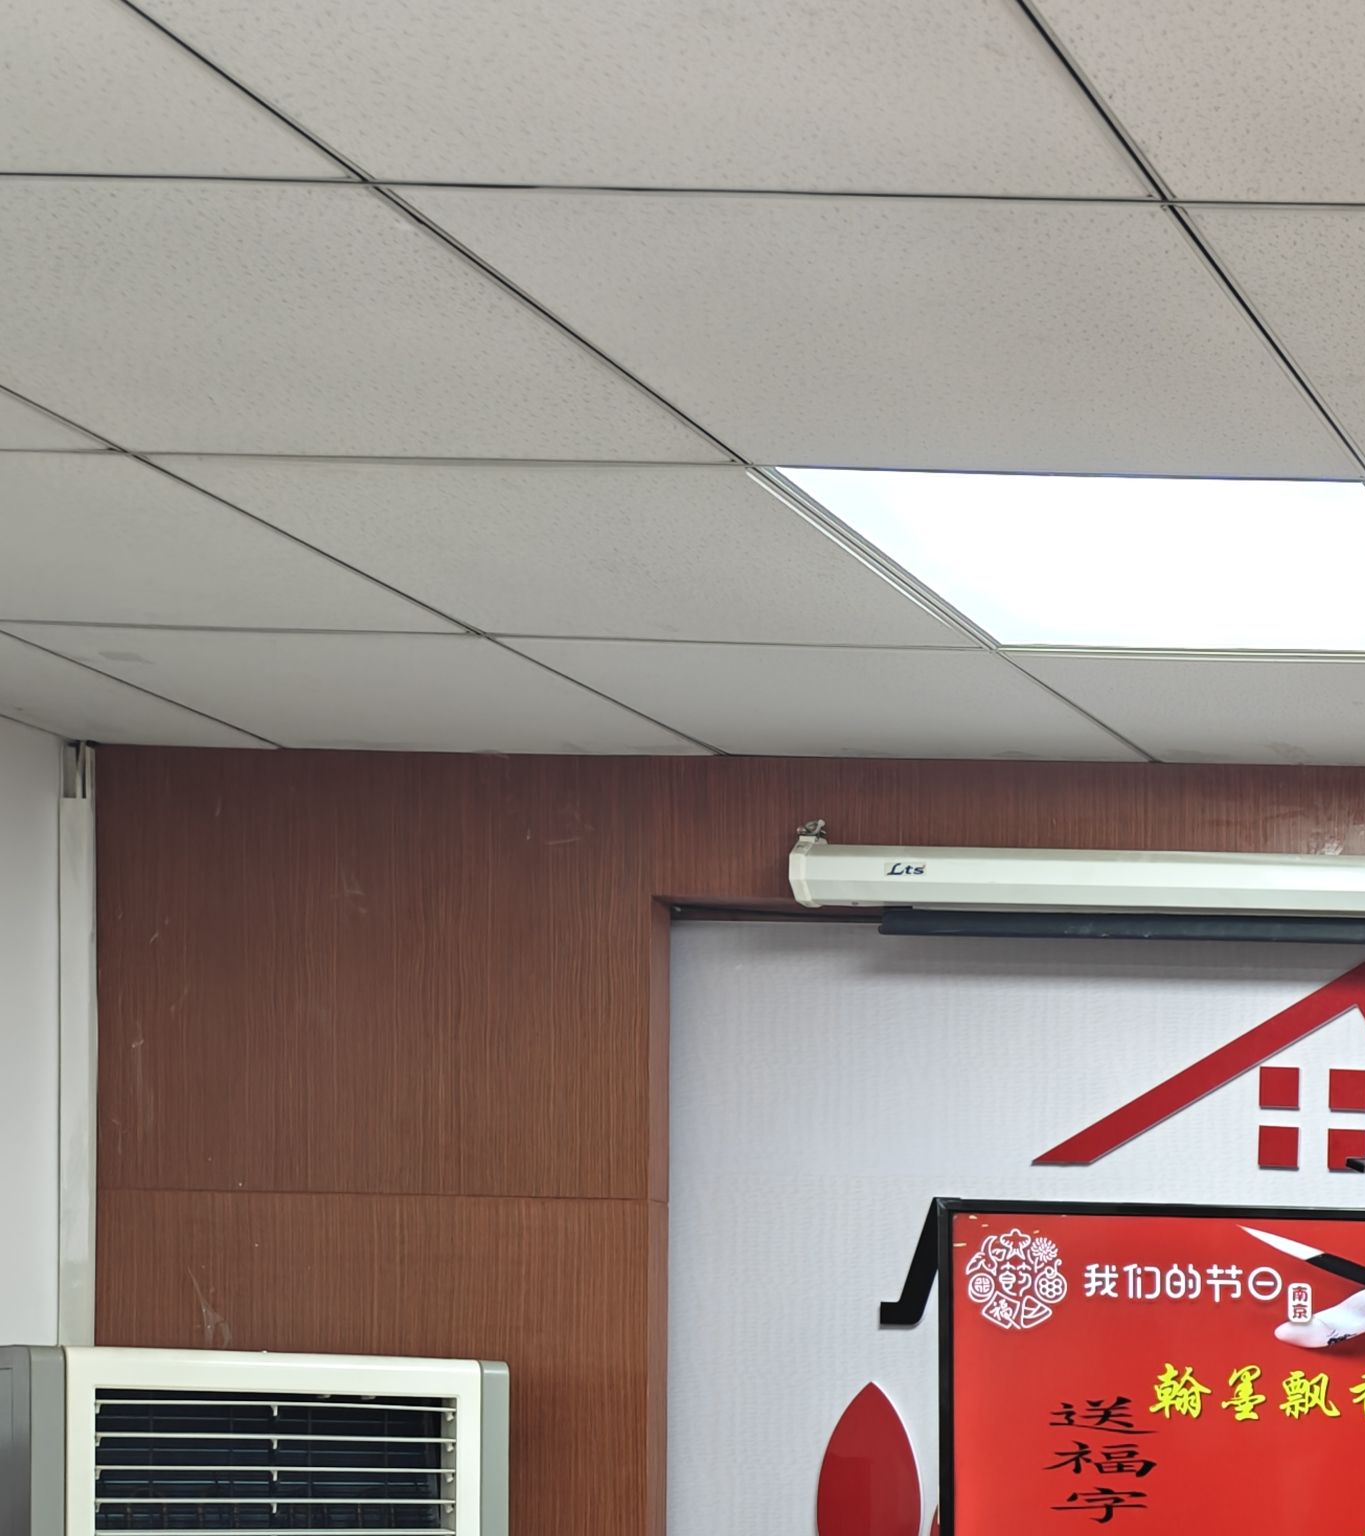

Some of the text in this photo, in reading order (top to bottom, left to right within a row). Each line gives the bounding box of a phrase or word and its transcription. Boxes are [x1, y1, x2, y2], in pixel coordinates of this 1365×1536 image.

[1083, 1263, 1284, 1303] 我们的节日
[1042, 1395, 1158, 1524] 送福字
